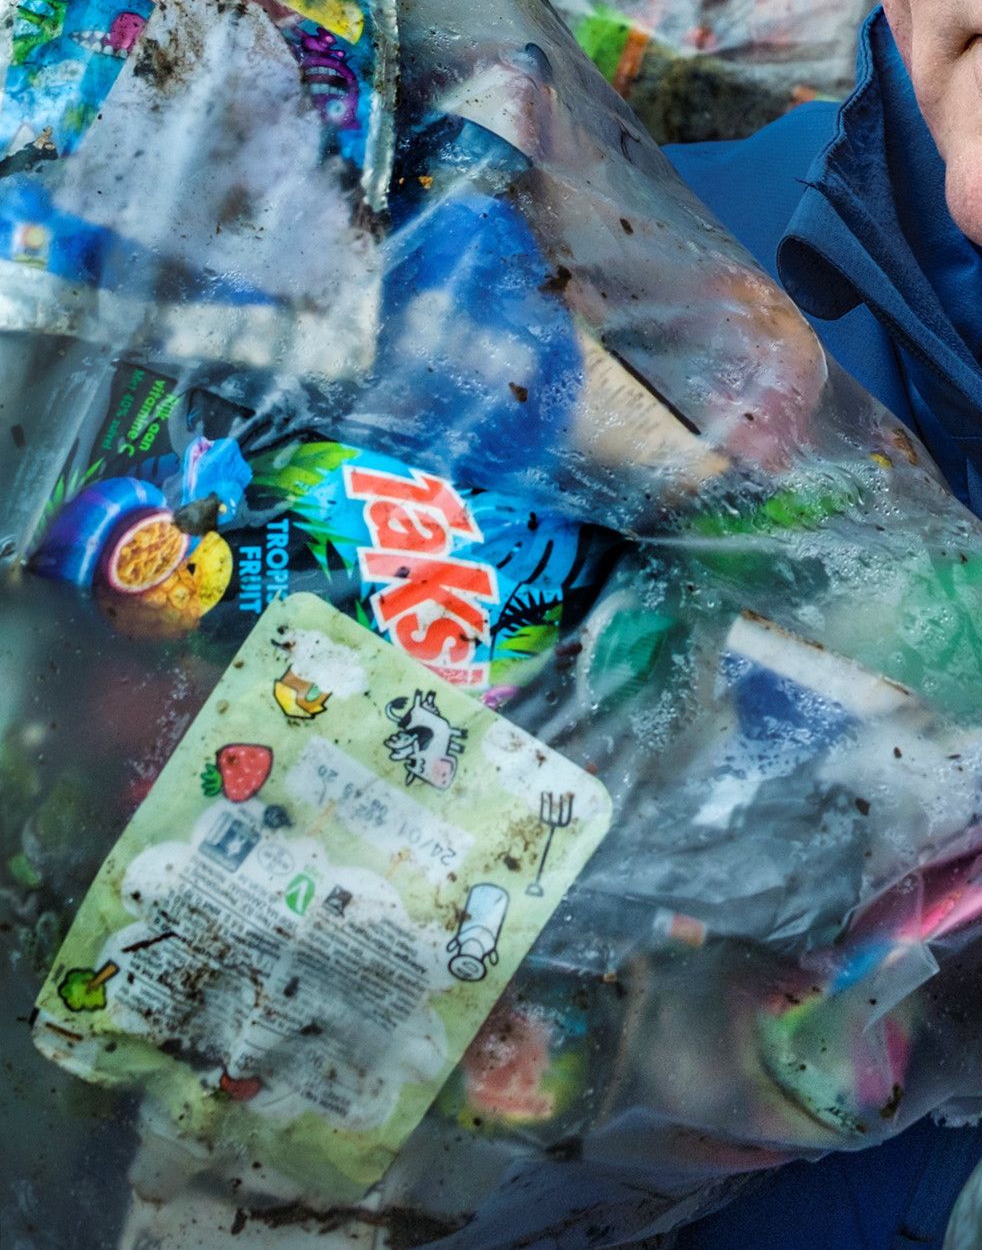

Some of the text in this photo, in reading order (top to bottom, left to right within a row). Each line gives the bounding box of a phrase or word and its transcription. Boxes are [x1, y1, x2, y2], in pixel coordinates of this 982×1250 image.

[118, 380, 166, 458] vitamine C
[138, 394, 181, 451] Rijk aan
[239, 546, 262, 614] FRUIT
[397, 819, 457, 867] 24/01
